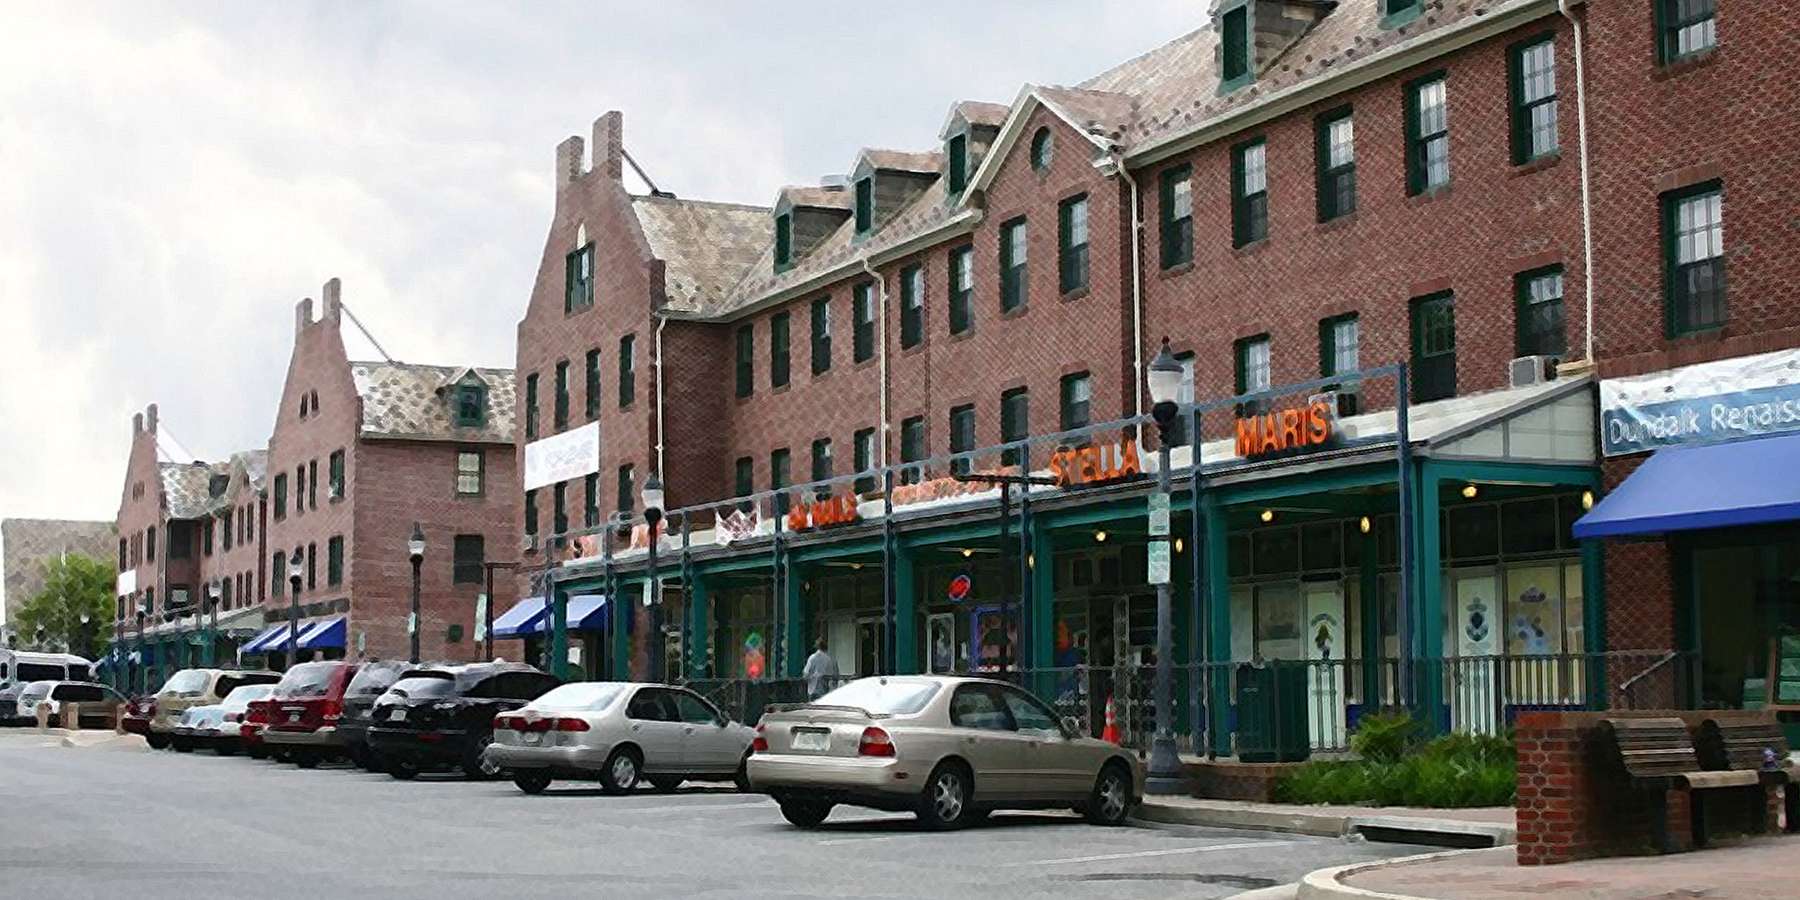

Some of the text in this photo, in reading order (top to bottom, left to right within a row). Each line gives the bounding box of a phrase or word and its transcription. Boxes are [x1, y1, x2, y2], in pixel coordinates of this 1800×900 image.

[1050, 440, 1140, 486] STELLA
[1234, 401, 1328, 457] MARIS
[1610, 397, 1800, 444] Dundalk Renais
